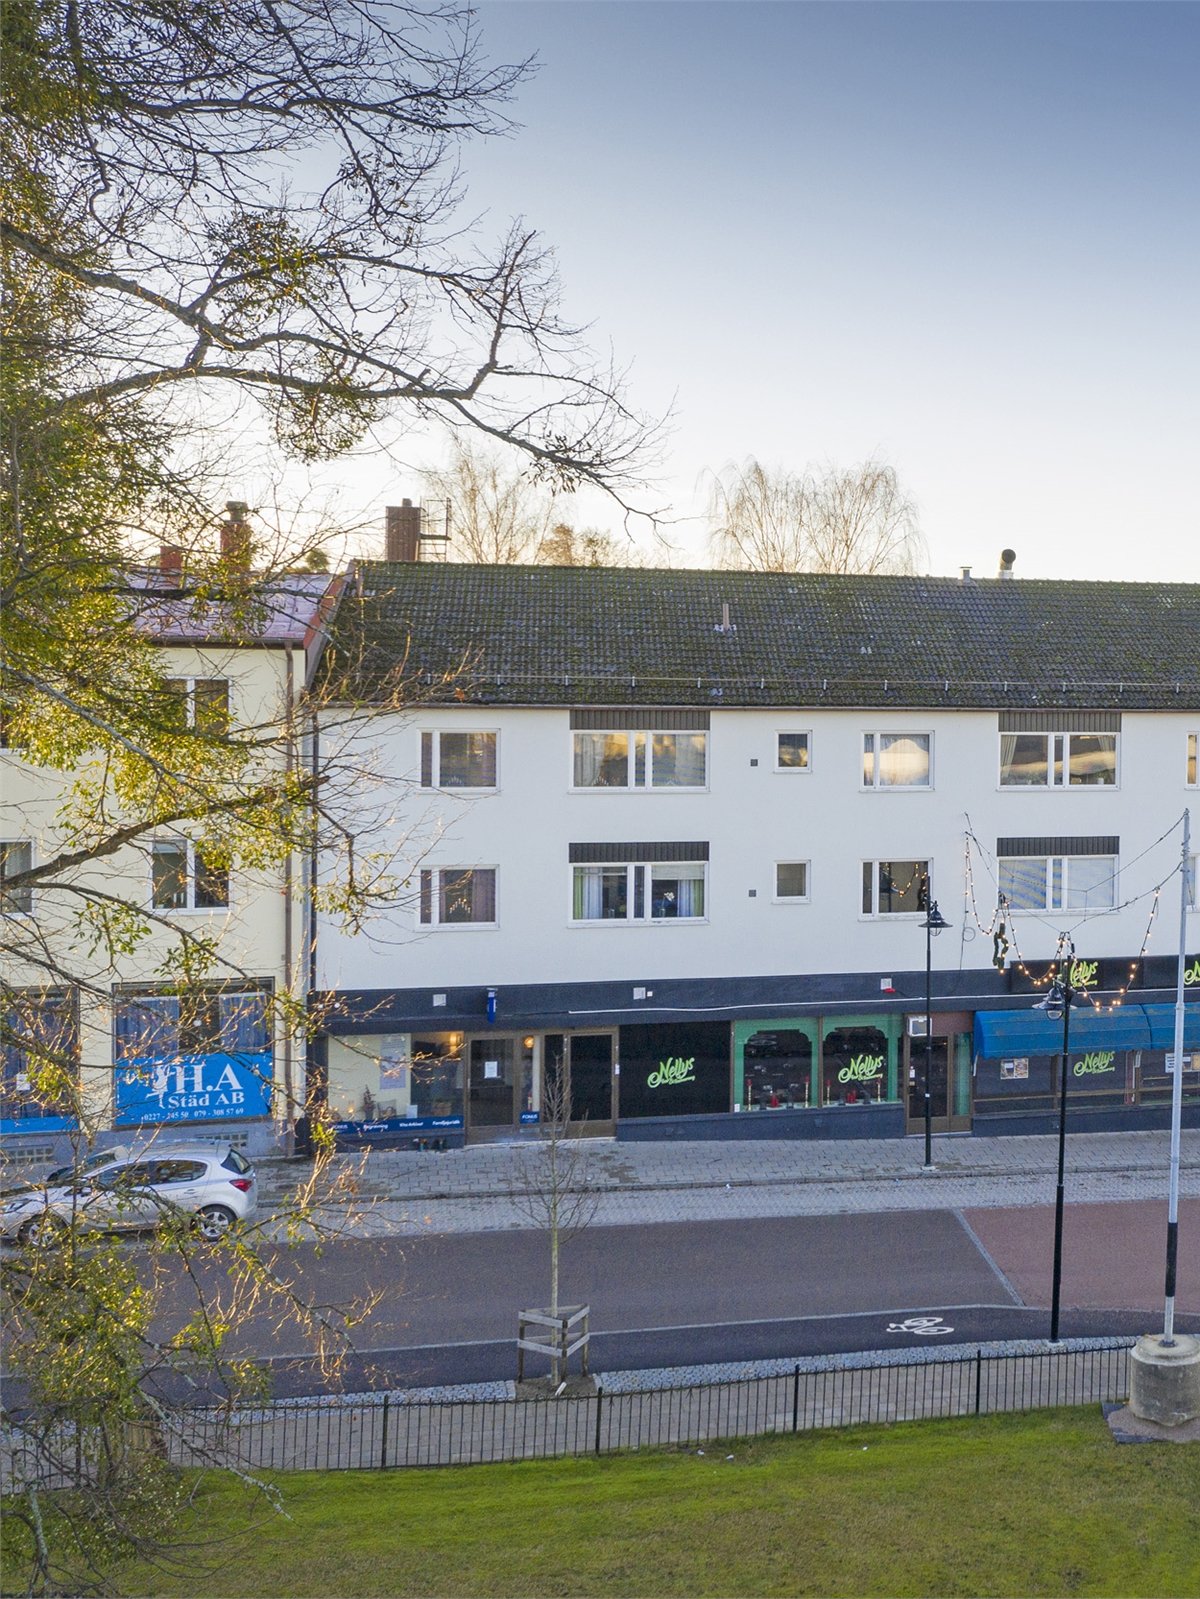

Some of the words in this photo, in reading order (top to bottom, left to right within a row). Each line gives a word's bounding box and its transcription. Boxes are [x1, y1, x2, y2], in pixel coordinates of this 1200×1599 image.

[647, 1057, 695, 1088] Nellys
[837, 1054, 884, 1083] Nellys
[1073, 1051, 1115, 1077] Nellys
[168, 1094, 210, 1109] Städ
[215, 1092, 245, 1106] AB
[143, 1113, 161, 1121] 0227
